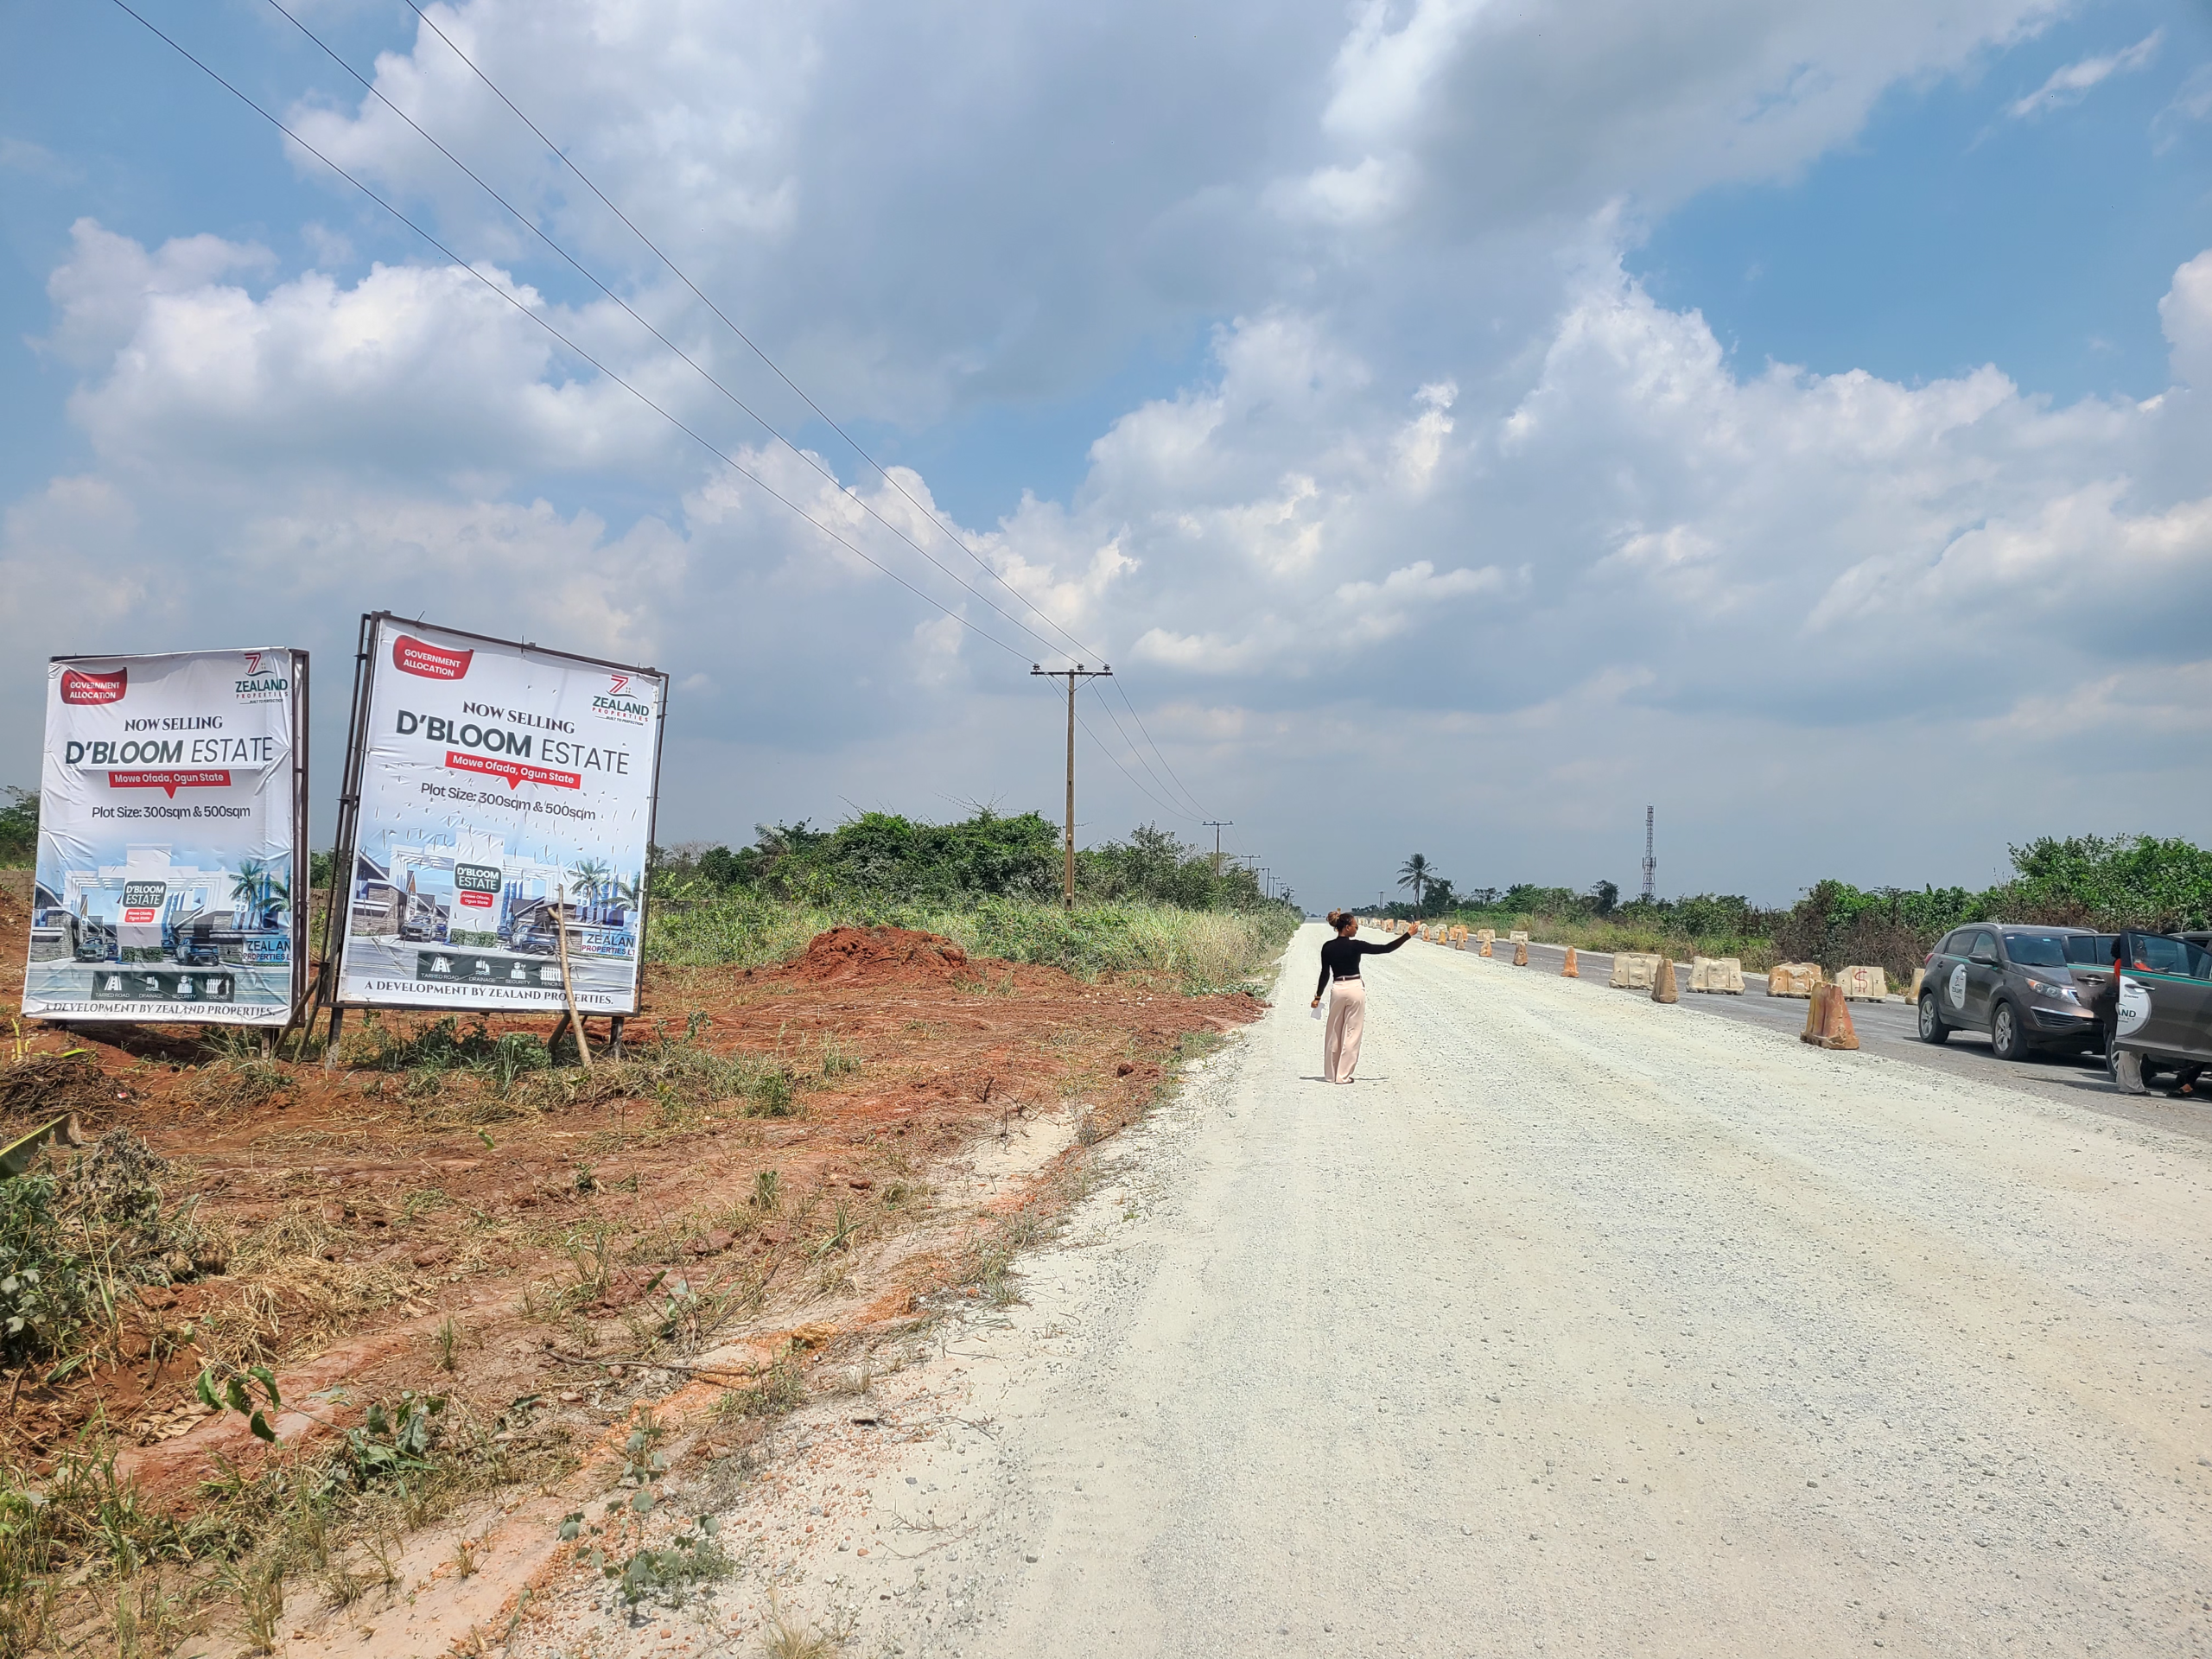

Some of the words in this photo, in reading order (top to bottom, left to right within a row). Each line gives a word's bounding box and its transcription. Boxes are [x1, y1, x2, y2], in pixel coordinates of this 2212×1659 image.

[404, 649, 461, 668] GOVERNMENT
[404, 659, 454, 677] ALLOCATION
[235, 678, 289, 692] ZEALAND
[592, 696, 650, 716] ZEALAND
[462, 701, 505, 720] NOW
[506, 709, 575, 734] SELLING
[592, 707, 648, 722] PROPERTIES
[124, 718, 161, 731] NOW
[162, 716, 223, 731] SELLING
[396, 709, 532, 758] D'BLOOM
[541, 739, 630, 775] ESTATE
[66, 740, 183, 765] D'BLOOM
[191, 737, 273, 762] ESTATE
[453, 754, 483, 768] Mowe
[485, 760, 518, 775] Ofada,
[521, 767, 547, 782] Ogun
[549, 772, 574, 784] State
[115, 774, 141, 783] Mowe
[142, 773, 173, 784] Ofada,
[174, 773, 198, 785] Ogun
[200, 772, 224, 782] State
[421, 783, 446, 797] Plot
[448, 787, 477, 802] Size:
[478, 791, 531, 811] 300sqm
[533, 801, 543, 812] &
[545, 802, 596, 821] 500sqm
[92, 806, 115, 818] Plot
[117, 806, 142, 817] Size:
[143, 806, 191, 819] 300sqm
[193, 807, 202, 817] &
[204, 806, 251, 819] 500sqm
[457, 867, 499, 880] D'BLOOM
[459, 876, 497, 890] ESTATE
[126, 894, 161, 905] ESTATE
[246, 940, 290, 951] ZEALAN
[587, 934, 634, 948] ZEALAN
[582, 945, 626, 955] PROPERTIES
[365, 981, 373, 989] A
[377, 982, 469, 996] DEVELOPMENT
[471, 987, 486, 996] BY
[489, 988, 541, 1000] ZEALAND
[544, 991, 613, 1005] PROERTIES.
[54, 1002, 137, 1013] DEVELOPMENT
[139, 1004, 154, 1013] BY
[156, 1004, 205, 1014] ZEALAND
[207, 1005, 276, 1016] PROPERTIES.
